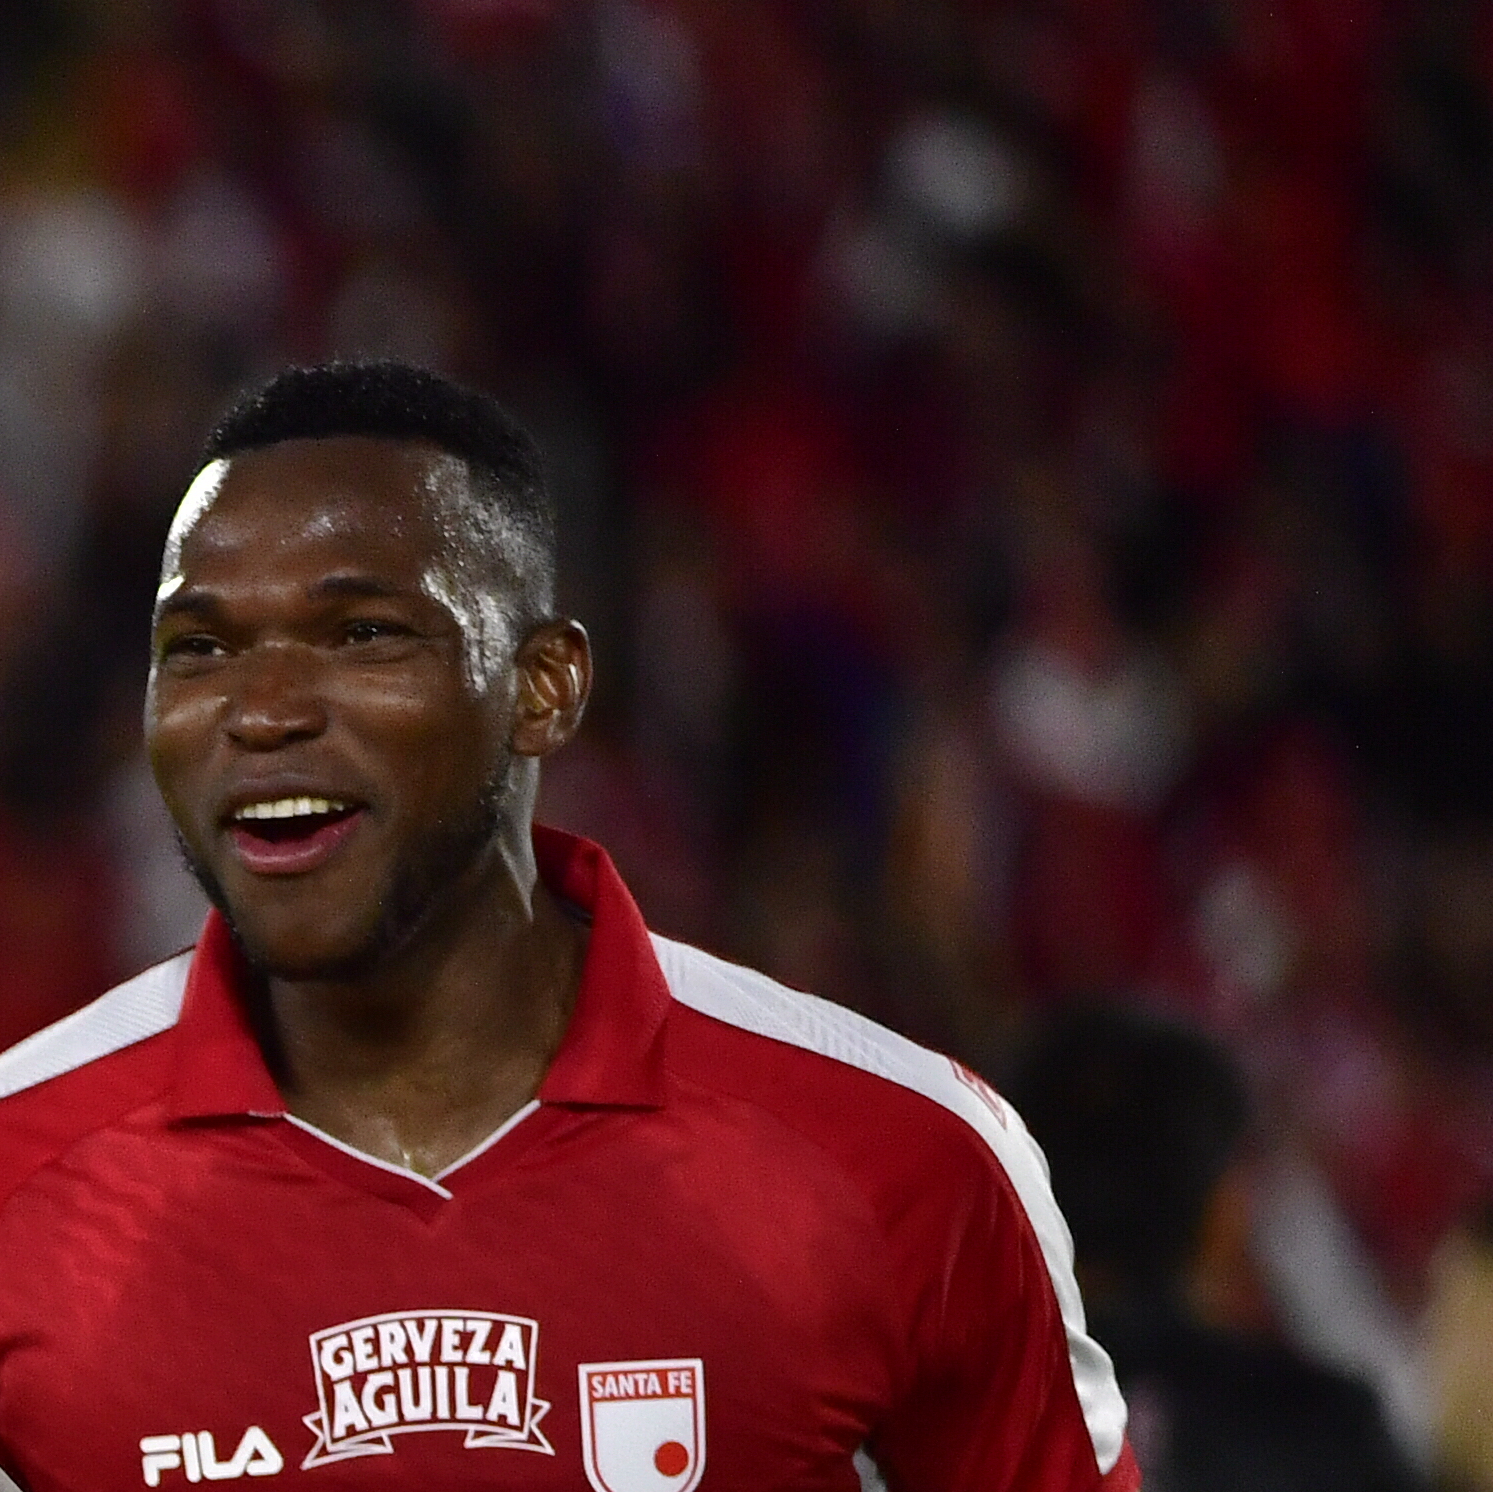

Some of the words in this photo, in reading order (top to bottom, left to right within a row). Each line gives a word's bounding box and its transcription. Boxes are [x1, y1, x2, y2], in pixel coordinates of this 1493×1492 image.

[333, 1368, 521, 1438] AGUILA
[591, 1372, 663, 1398] SANTA
[667, 1371, 694, 1395] FE
[139, 1425, 284, 1487] FILA
